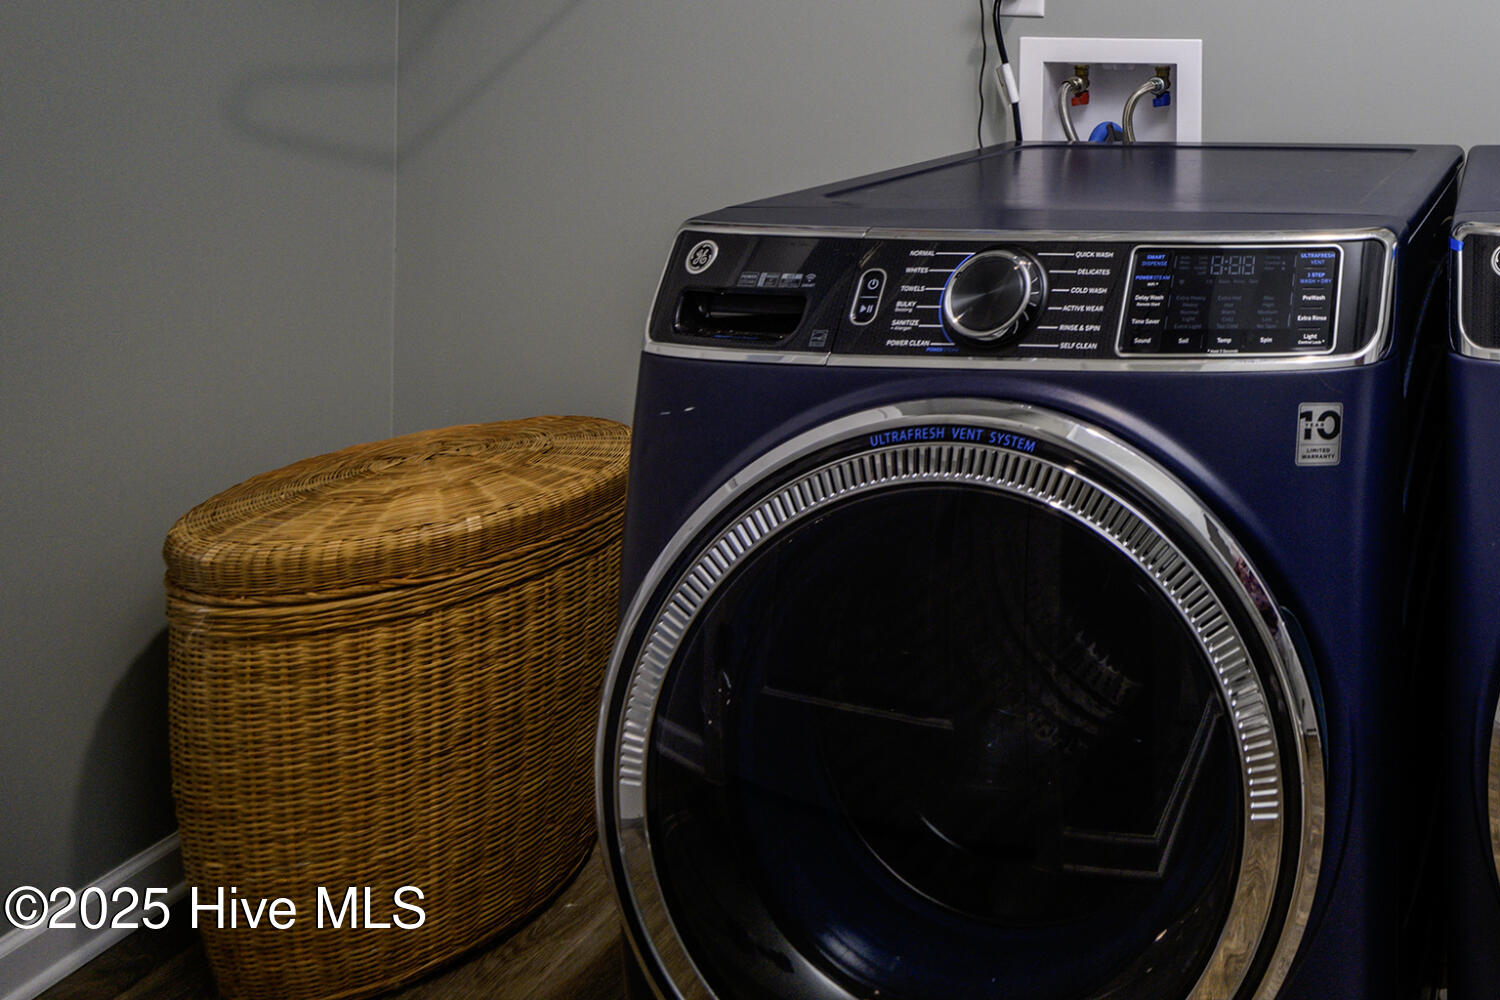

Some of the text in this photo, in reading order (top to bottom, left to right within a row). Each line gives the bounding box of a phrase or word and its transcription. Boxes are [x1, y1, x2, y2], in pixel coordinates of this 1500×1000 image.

[909, 249, 935, 257] NORMAL
[1075, 251, 1095, 259] QUICK
[905, 266, 929, 274] WHITES
[1070, 286, 1108, 294] COLD WASH
[1062, 304, 1104, 312] ACTIVE WEAR
[1058, 324, 1101, 332] RINSE & SPIN
[1259, 336, 1273, 344] Spin
[1303, 333, 1318, 341] Light
[886, 339, 931, 347] POWER CLEAN
[1059, 342, 1098, 350] SELF CLEAN
[1299, 410, 1342, 440] 10
[869, 426, 1037, 453] ULTRAFRESH VENT SYSTEM
